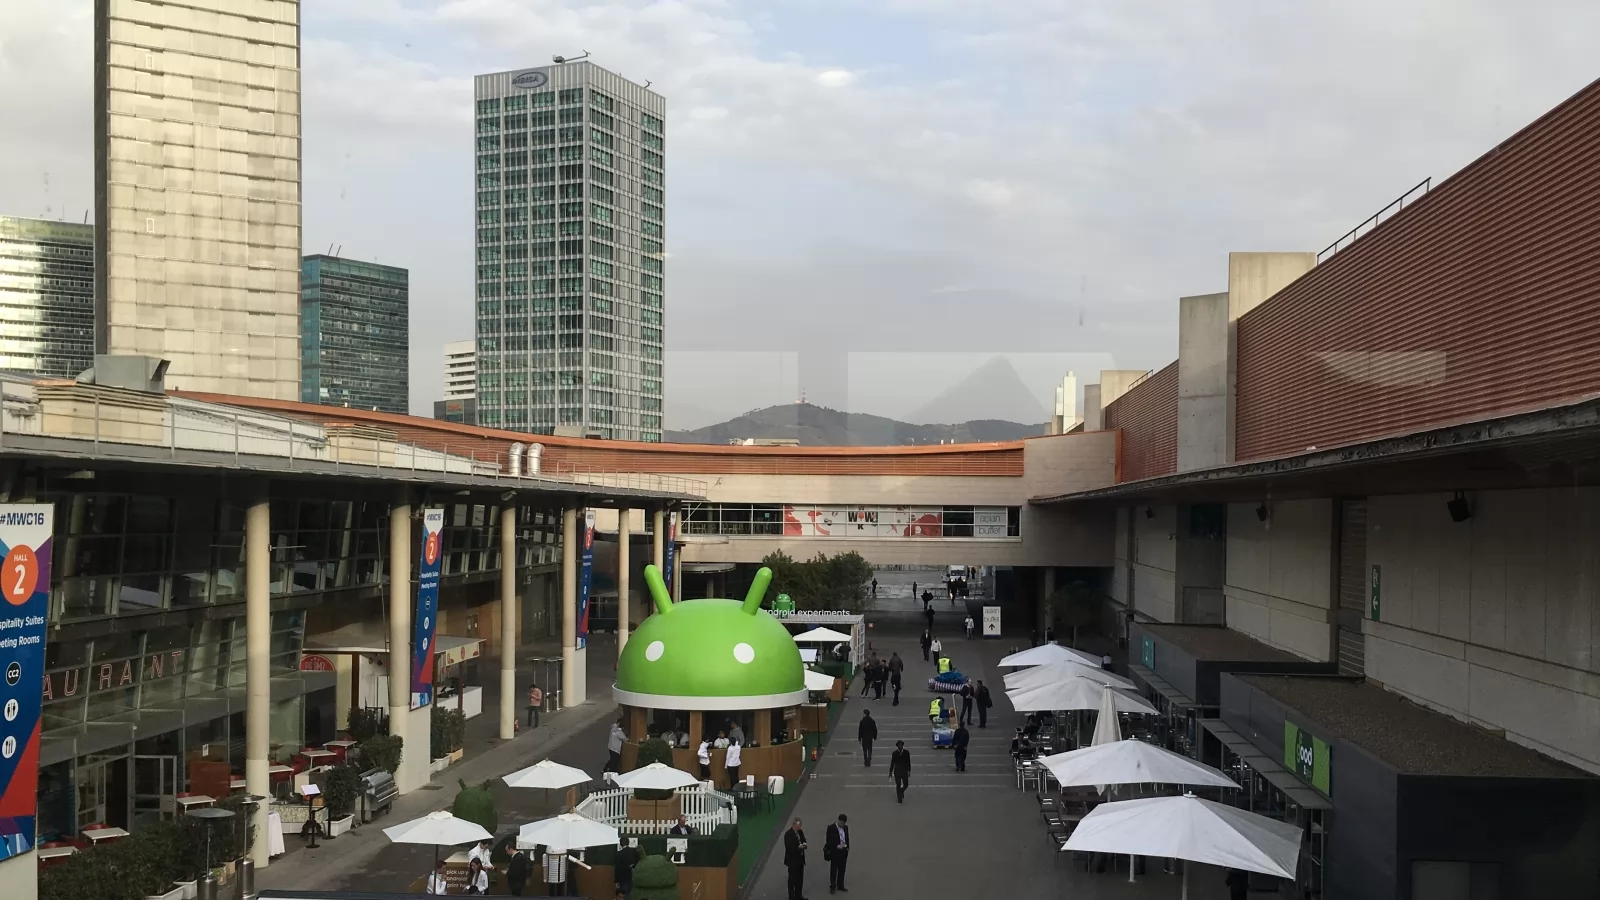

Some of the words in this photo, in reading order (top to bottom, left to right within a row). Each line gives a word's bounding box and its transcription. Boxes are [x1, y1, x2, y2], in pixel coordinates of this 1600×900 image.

[0, 512, 44, 526] #MWC16
[13, 554, 28, 562] HALL
[13, 564, 26, 595] 2
[766, 608, 796, 616] ndroid
[797, 608, 851, 618] experiments
[25, 616, 44, 626] Suites
[18, 635, 40, 646] Rooms
[8, 669, 20, 679] CC2
